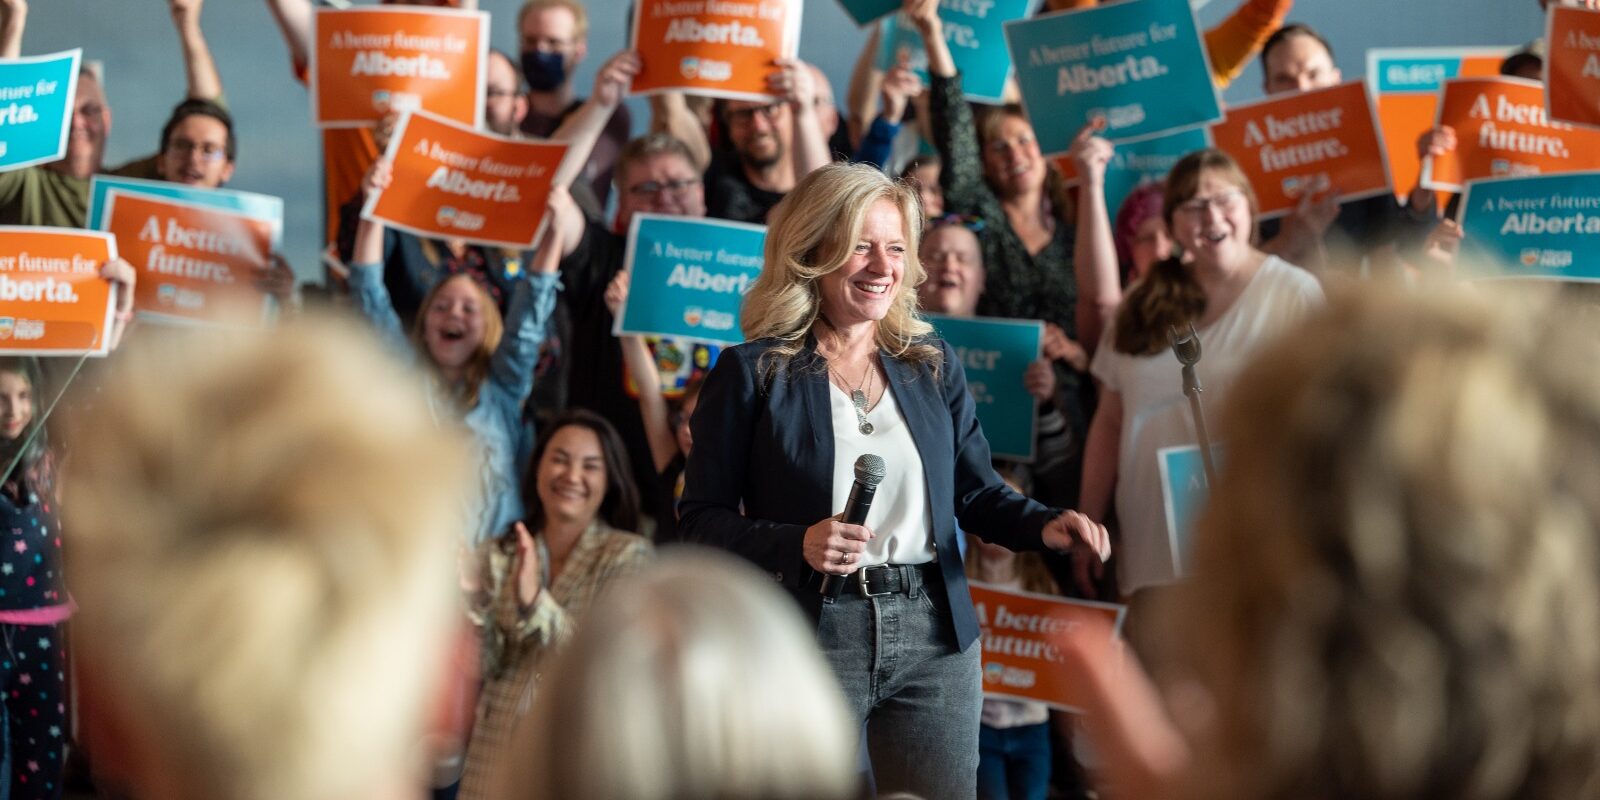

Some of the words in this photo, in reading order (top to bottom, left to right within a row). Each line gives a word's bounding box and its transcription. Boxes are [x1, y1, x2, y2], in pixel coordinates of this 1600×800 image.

[331, 31, 343, 49] A
[343, 30, 392, 50] better
[393, 31, 440, 53] future
[442, 34, 467, 54] for
[663, 17, 765, 48] Alberta.
[1030, 48, 1042, 66] A
[1041, 43, 1089, 64] better
[1091, 35, 1148, 57] future
[1149, 22, 1177, 43] for
[351, 50, 451, 80] Alberta.
[1057, 55, 1169, 96] Alberta.
[35, 79, 58, 97] for
[1469, 92, 1490, 119] A
[1243, 119, 1265, 149] A
[1264, 107, 1343, 141] better
[1479, 120, 1570, 158] future.
[413, 138, 429, 157] A
[429, 140, 479, 171] better
[478, 156, 524, 178] future
[525, 161, 546, 178] for
[1260, 137, 1349, 174] future.
[426, 165, 521, 203] Alberta.
[1481, 197, 1494, 212] A
[1498, 196, 1547, 212] better
[138, 214, 161, 243] A
[19, 251, 71, 273] future
[73, 253, 97, 273] for
[147, 244, 235, 284] future.
[650, 241, 663, 257] A
[665, 241, 713, 262] better
